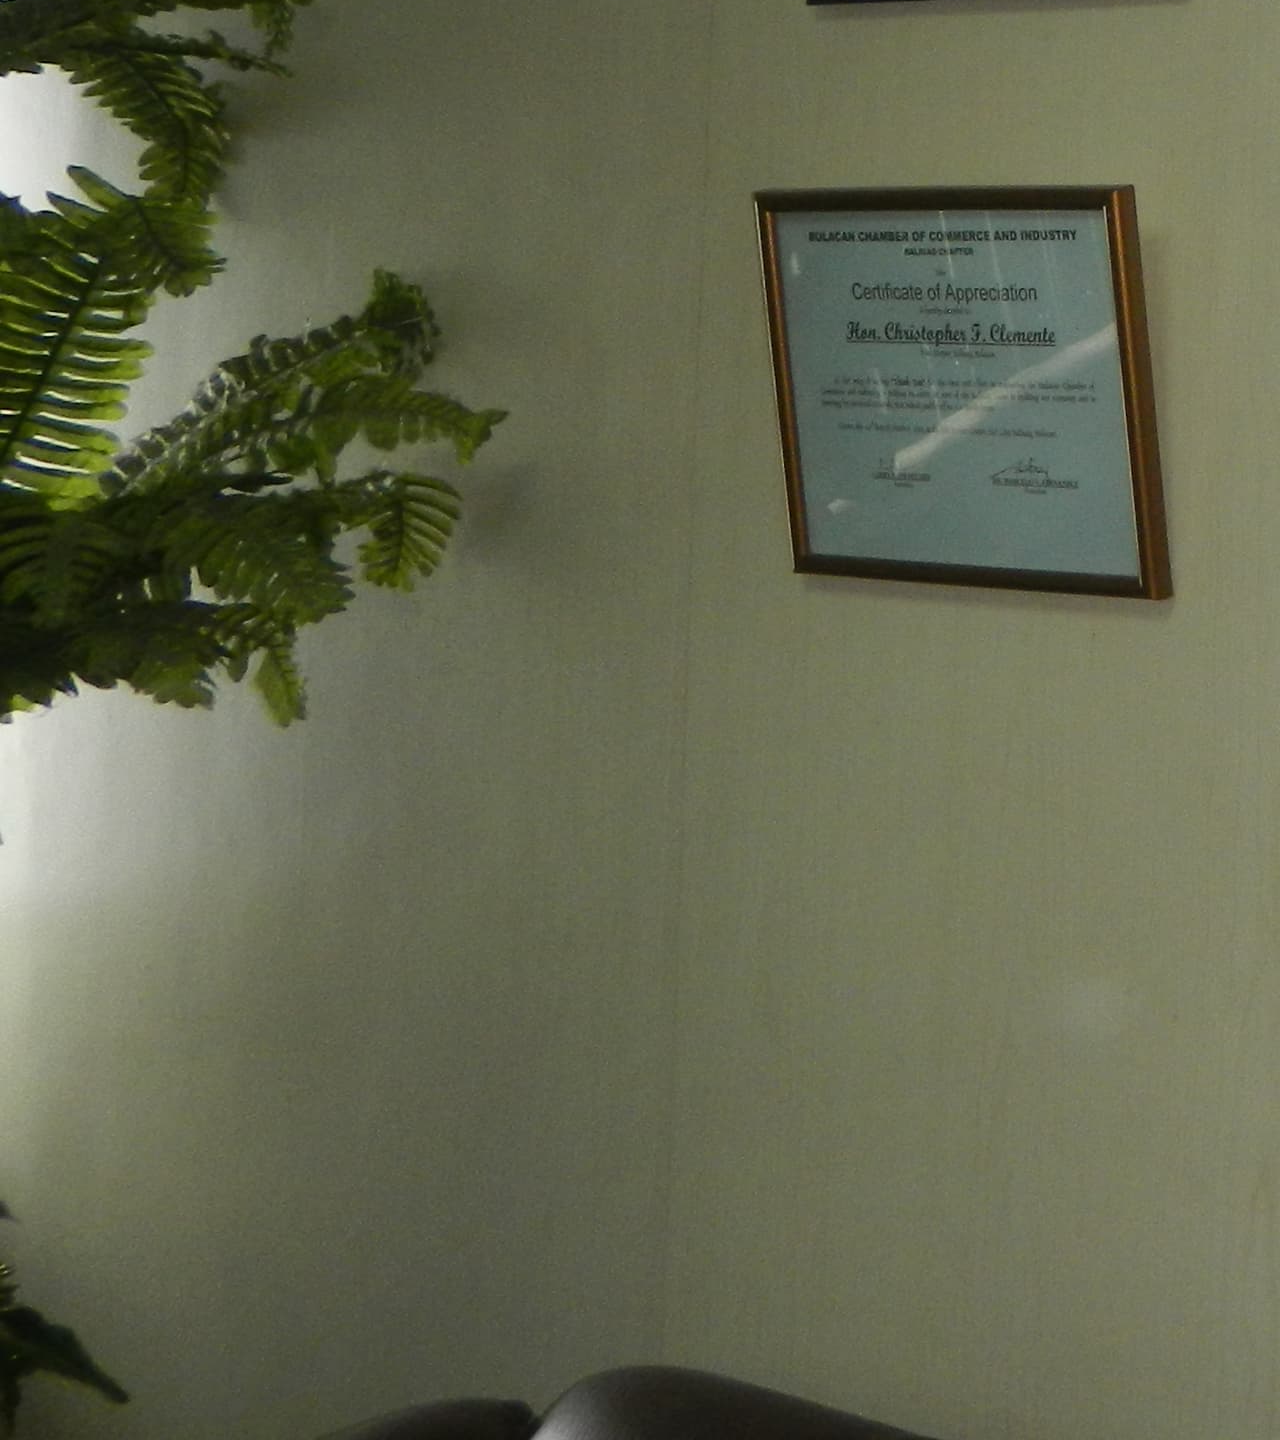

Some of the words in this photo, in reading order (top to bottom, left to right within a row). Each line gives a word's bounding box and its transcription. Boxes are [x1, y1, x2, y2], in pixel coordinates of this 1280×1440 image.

[858, 230, 910, 243] CHAMBER
[912, 230, 926, 243] OF
[993, 229, 1018, 242] AND
[1020, 229, 1078, 242] INDUSTRY
[852, 282, 923, 302] Certificate
[926, 282, 942, 302] of
[945, 283, 1038, 306] Appreciation
[846, 321, 881, 343] Hon.
[884, 321, 967, 347] Christopher
[989, 324, 1057, 345] Clemente
